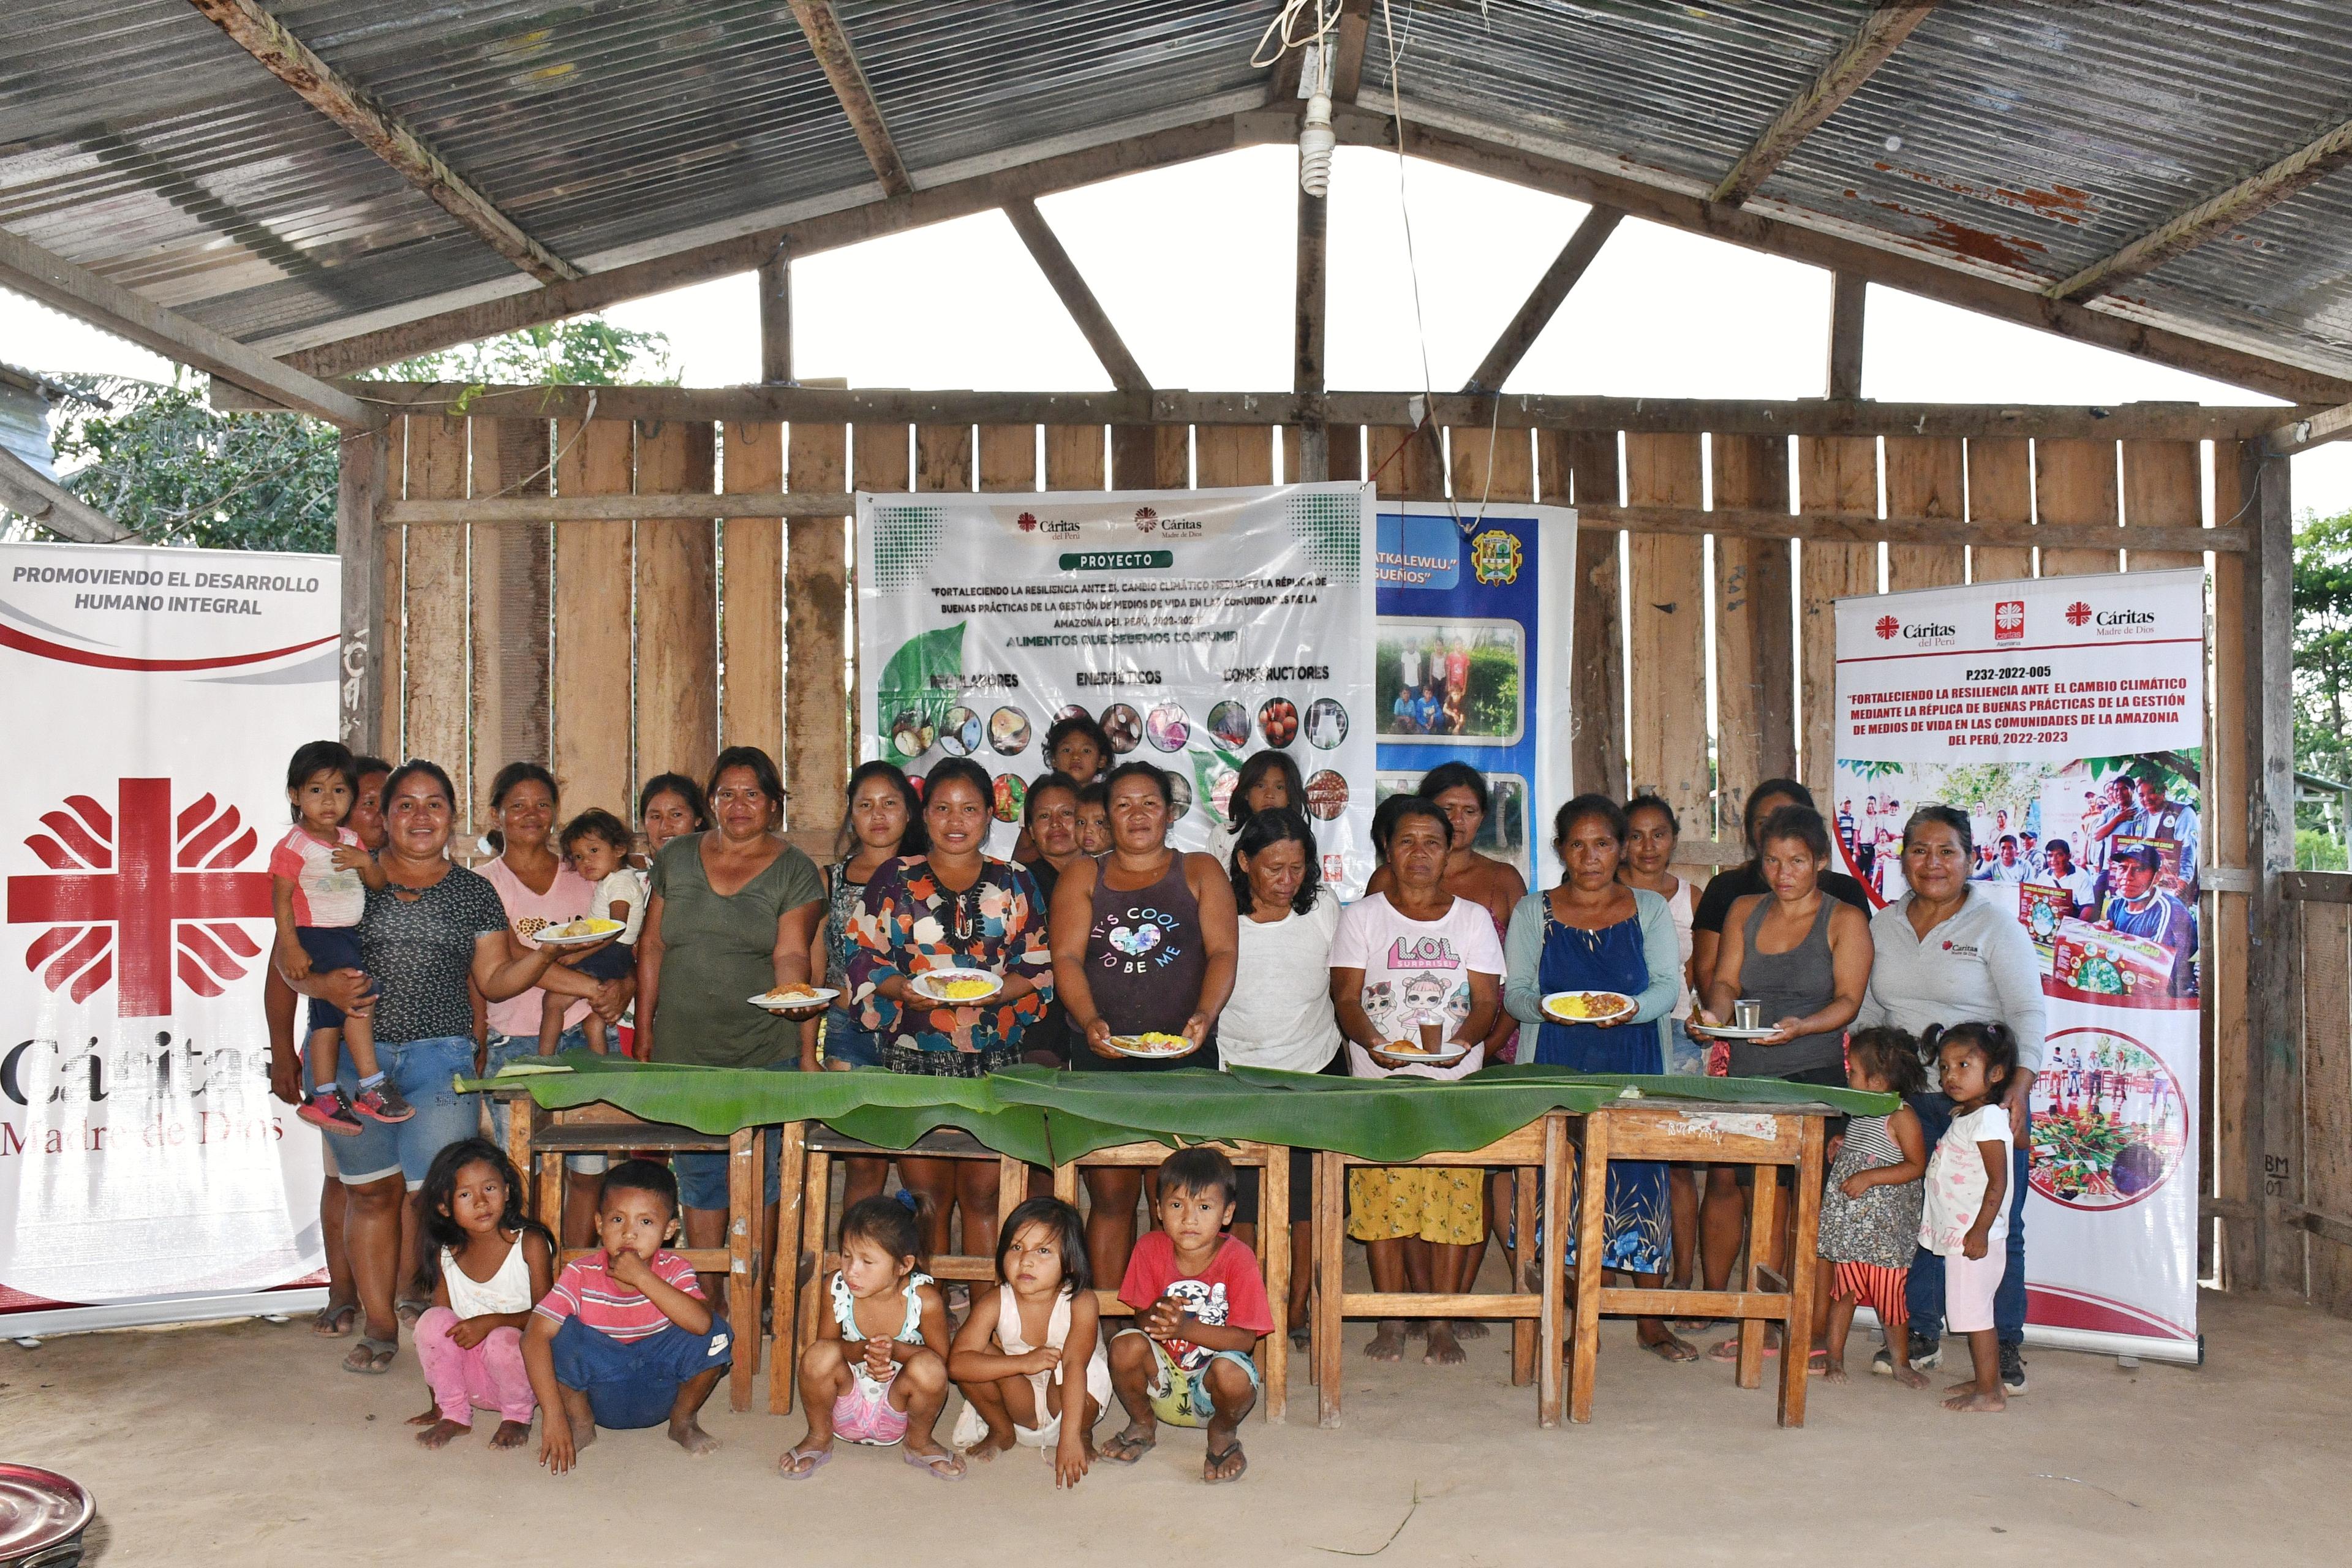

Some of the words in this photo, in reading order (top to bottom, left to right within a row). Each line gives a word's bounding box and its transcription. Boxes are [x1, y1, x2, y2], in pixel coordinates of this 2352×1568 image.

[1040, 520, 1080, 533] Cáritas
[1162, 519, 1202, 530] Cáritas
[1080, 554, 1152, 567] PROYECTO
[12, 566, 164, 587] PROMOVIENDO
[167, 571, 190, 587] EL
[195, 573, 319, 593] DESARROLLO
[1011, 586, 1023, 595] LA
[1025, 584, 1079, 595] RESILIENCIA
[1081, 584, 1106, 593] ANTE
[1122, 582, 1157, 592] CAMBIO
[74, 594, 164, 611] HUMANO
[168, 596, 262, 615] INTEGRAL
[941, 604, 976, 613] BUENAS
[979, 600, 1028, 612] PRÁCTICAS
[1031, 603, 1042, 611] DE
[1045, 602, 1057, 611] LA
[1059, 599, 1098, 611] GESTIÓN
[1100, 601, 1112, 609] DE
[1114, 600, 1148, 609] MEDIOS
[1150, 600, 1163, 608] DE
[1165, 598, 1186, 608] VIDA
[1189, 598, 1201, 607] EN
[1054, 616, 1102, 628] AMAZONÍA
[2096, 609, 2155, 626] Cáritas
[1903, 623, 1956, 639] Cáritas
[1006, 635, 1077, 647] ALIMENTOS
[1081, 635, 1107, 645] QUE
[1918, 638, 1932, 647] del
[1935, 636, 1956, 646] Perú
[1966, 666, 2051, 681] P.232-2022-005
[1936, 689, 1950, 699] LA
[1952, 685, 2018, 698] RESILIENCIA
[2021, 684, 2049, 695] ANTE
[2054, 683, 2067, 693] EL
[2069, 681, 2117, 693] CAMBIO
[2120, 677, 2187, 691] CLIMÁTICO
[1850, 707, 1902, 720] MEDIANTE
[1904, 706, 1917, 717] LA
[1920, 703, 1964, 715] RÉPLICA
[1966, 703, 1980, 714] DE
[1983, 701, 2027, 713] BUENAS
[2029, 698, 2095, 711] PRÁCTICAS
[2098, 698, 2113, 709] DE
[2116, 696, 2130, 707] LA
[2132, 693, 2185, 707] GESTIÓN
[1853, 725, 1866, 735] DE
[1868, 722, 1909, 734] MEDIOS
[1910, 721, 1924, 732] DE
[1926, 720, 1953, 731] VIDA
[1955, 719, 1968, 729] EN
[1971, 718, 1992, 729] LAS
[1994, 714, 2078, 728] COMUNIDADES
[2081, 714, 2095, 725] DE
[2098, 714, 2112, 724] LA
[2115, 712, 2179, 724] AMAZONIA
[1948, 735, 1967, 746] DEL
[1969, 733, 2000, 745] PERÚ,
[2003, 731, 2068, 744] 2022-2023
[1127, 907, 1180, 932] COOL
[1099, 952, 1117, 968] TO
[1123, 960, 1147, 974] BE
[1155, 945, 1181, 968] ME
[2266, 1155, 2289, 1174] BM
